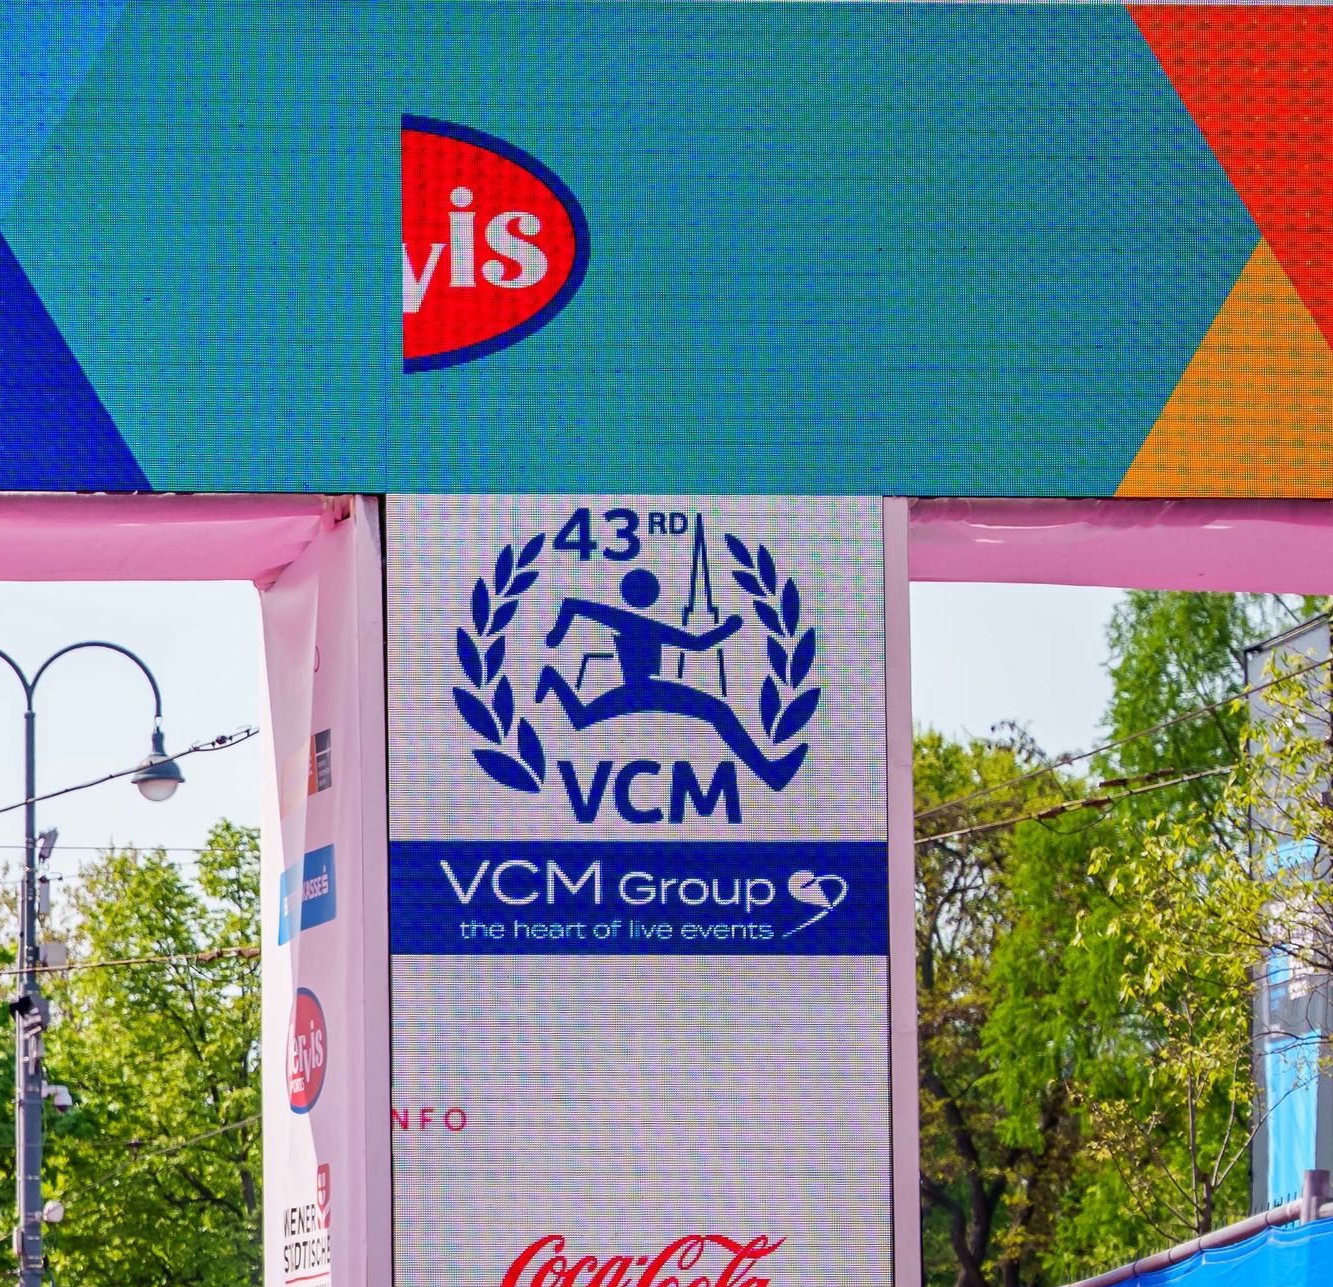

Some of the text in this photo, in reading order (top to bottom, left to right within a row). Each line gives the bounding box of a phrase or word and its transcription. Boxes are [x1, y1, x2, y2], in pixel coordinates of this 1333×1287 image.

[557, 760, 742, 825] VCM
[439, 858, 776, 912] VCM Group
[460, 919, 774, 941] the heart of live events
